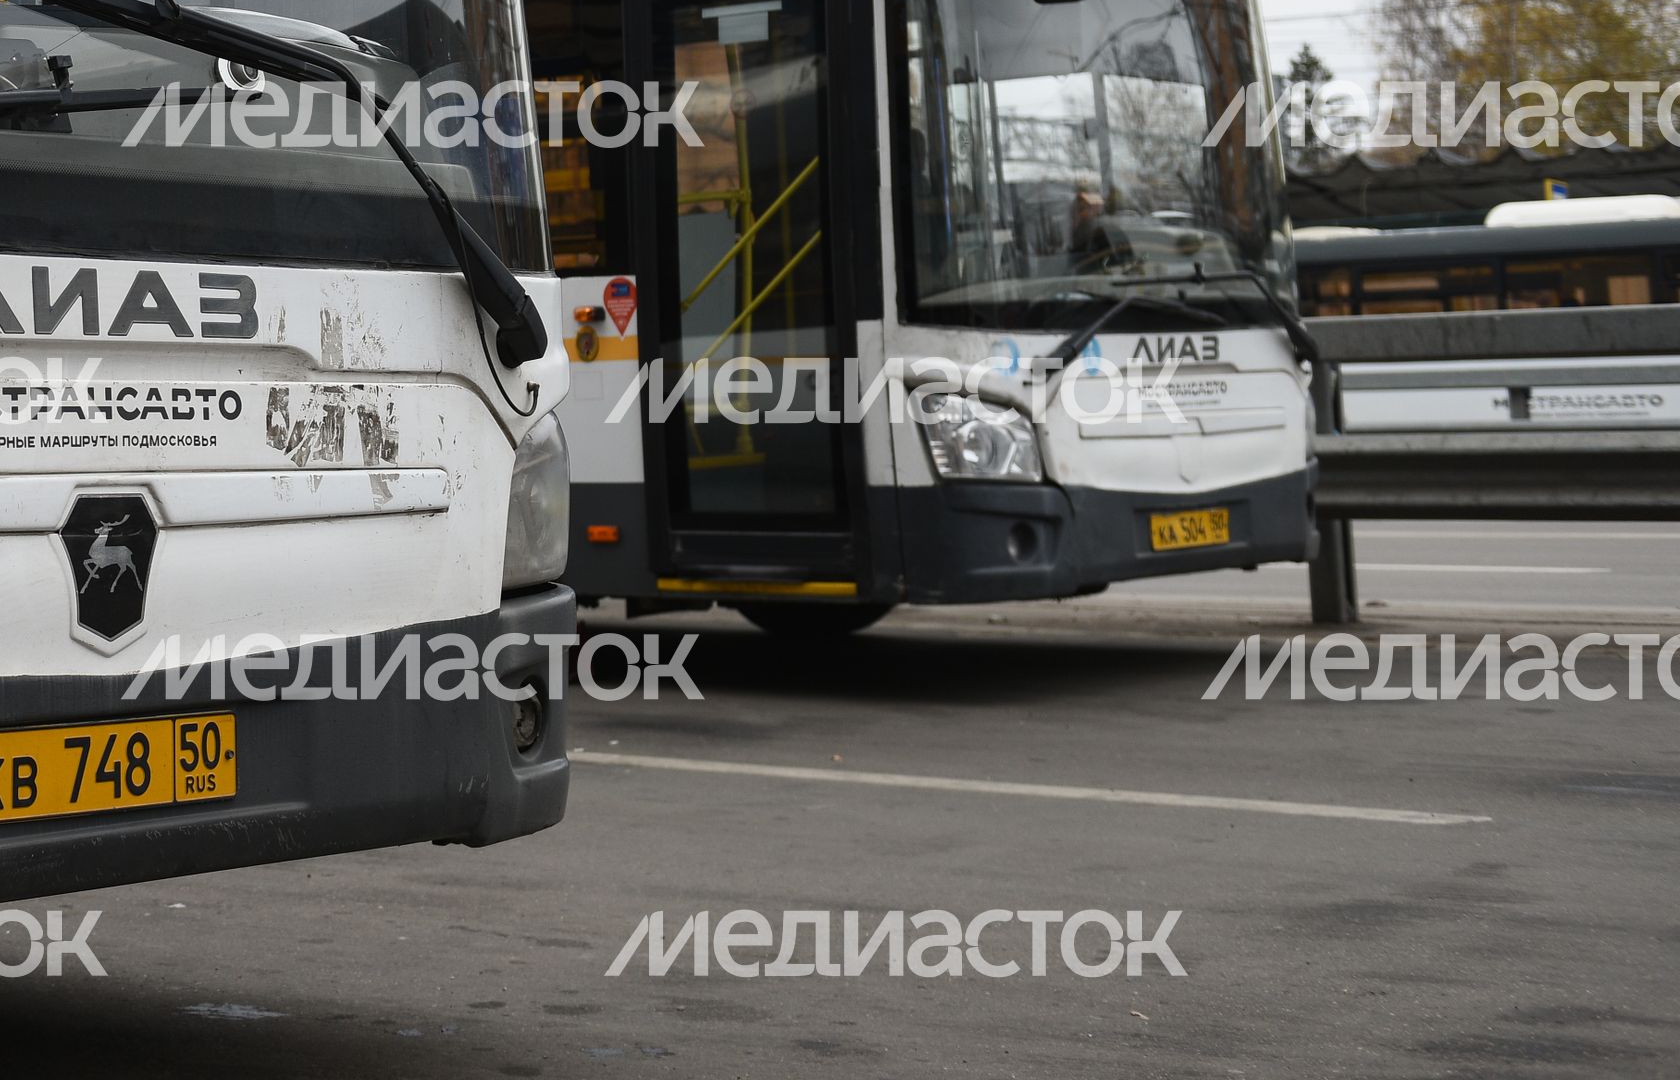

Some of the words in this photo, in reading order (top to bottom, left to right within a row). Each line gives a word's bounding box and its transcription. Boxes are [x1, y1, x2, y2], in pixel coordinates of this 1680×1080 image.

[1131, 334, 1220, 363] ЛИАЗ
[40, 435, 119, 449] МАРШРУТЫ
[122, 435, 217, 448] ПОДМОСКОВЬЯ
[64, 731, 151, 803] 748
[179, 722, 220, 772] 50
[186, 773, 216, 794] RUS
